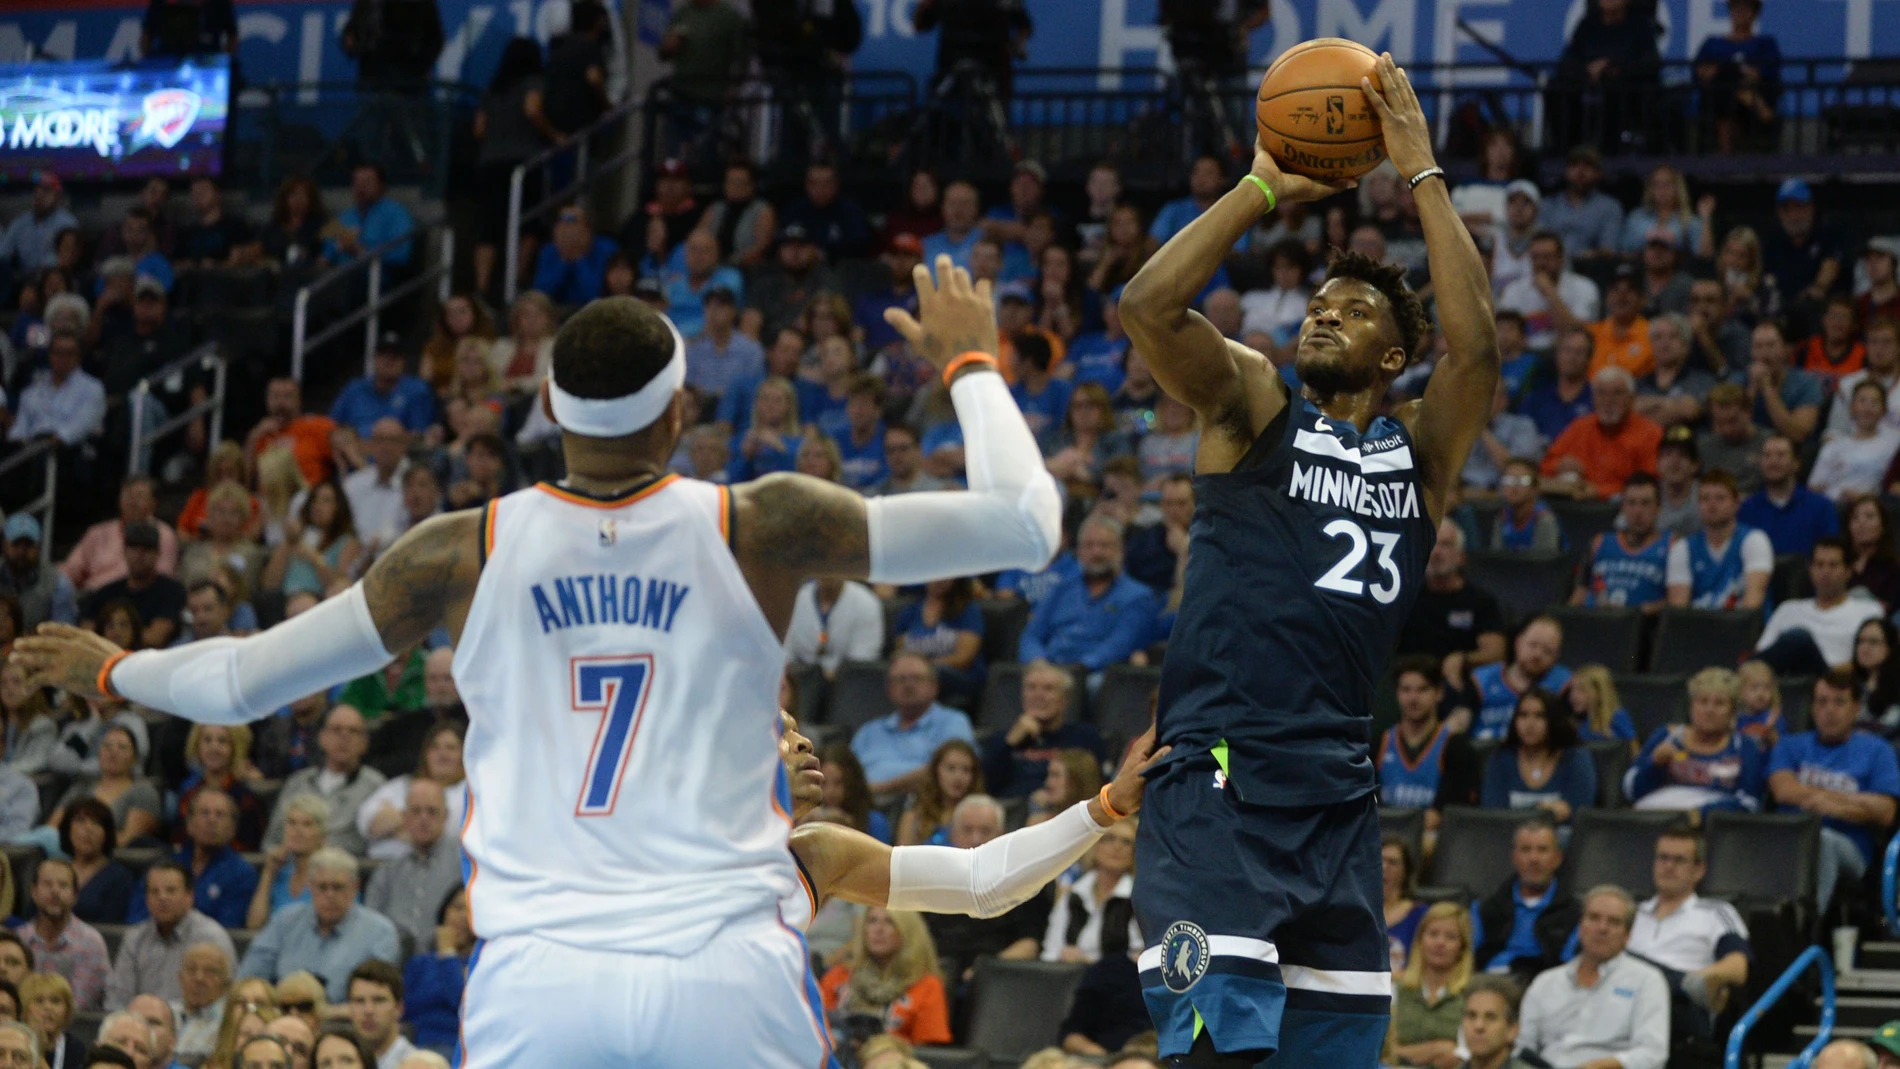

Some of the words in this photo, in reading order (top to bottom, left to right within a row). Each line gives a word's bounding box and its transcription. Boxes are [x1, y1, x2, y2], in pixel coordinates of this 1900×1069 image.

[9, 108, 121, 157] MOORE
[1281, 140, 1383, 169] SPALDING
[1374, 434, 1404, 451] fitbit
[1288, 460, 1420, 519] MINNESOTA
[1313, 519, 1401, 604] 23
[530, 573, 691, 634] ANTHONY
[569, 652, 655, 817] 7
